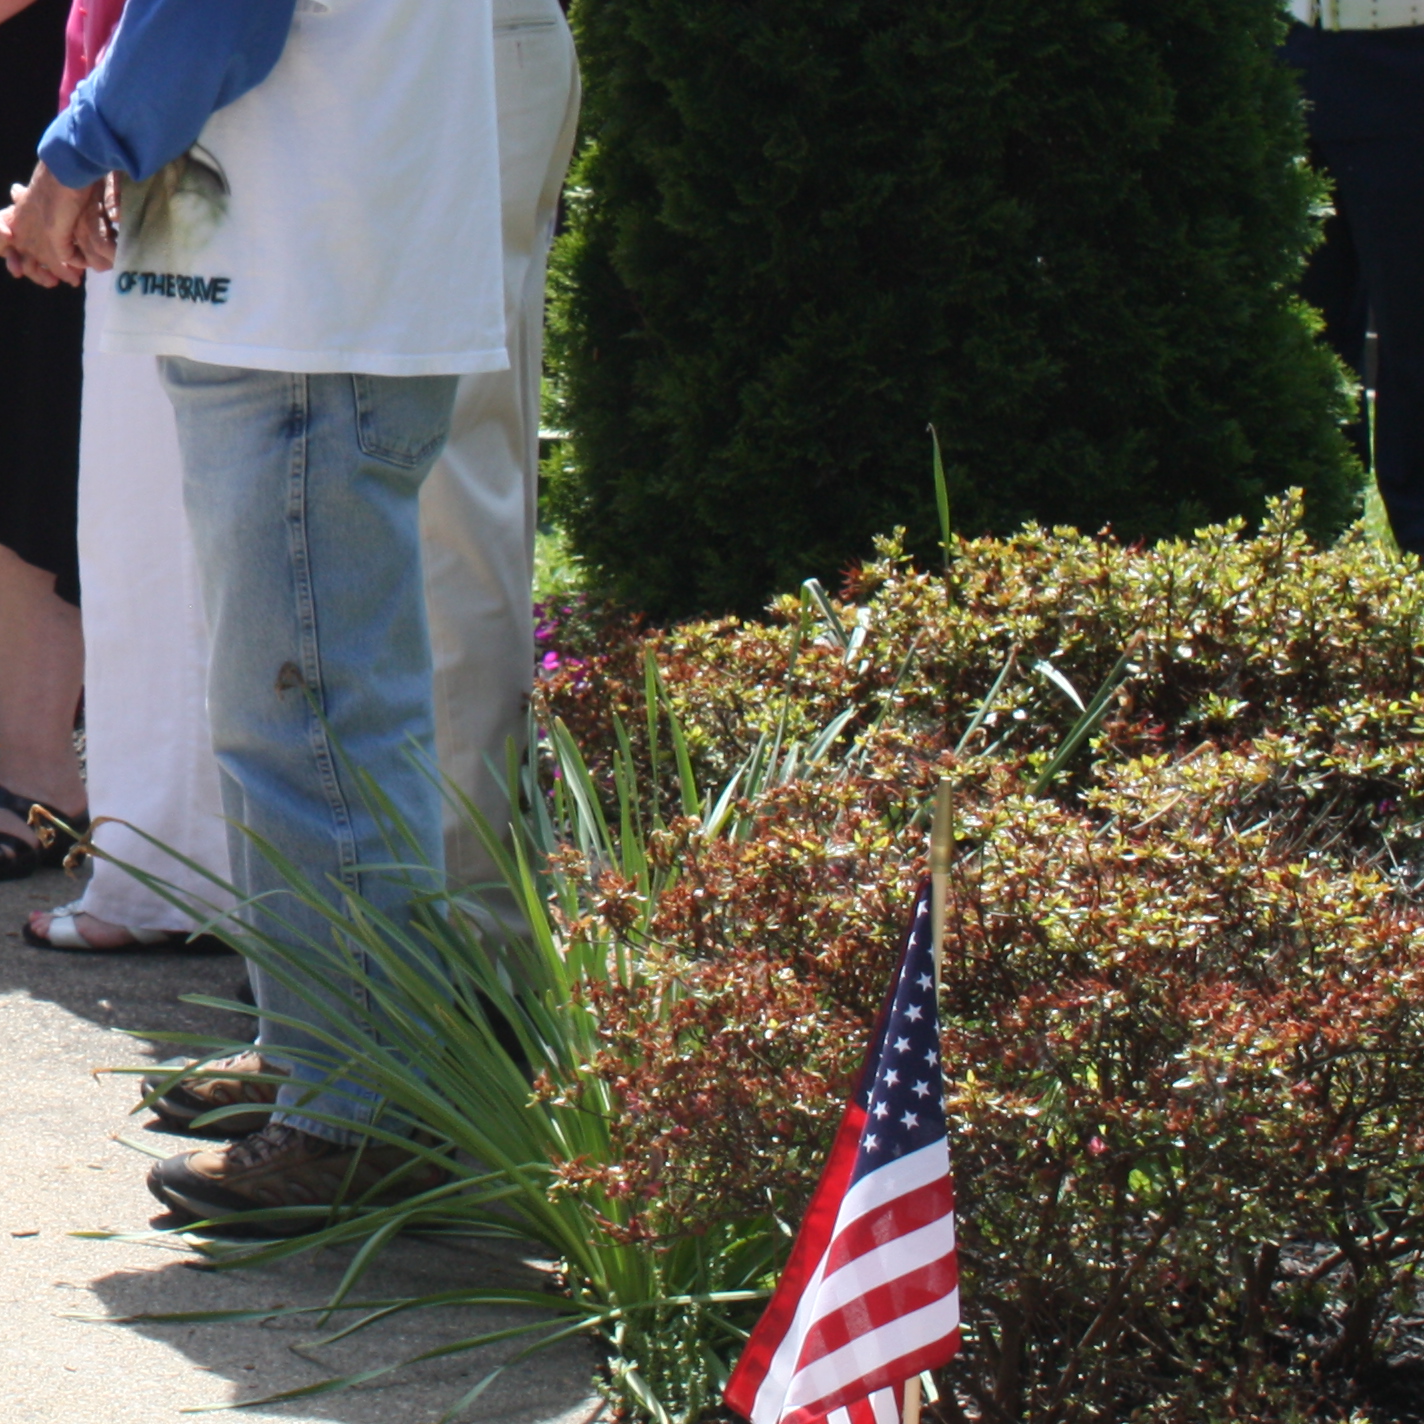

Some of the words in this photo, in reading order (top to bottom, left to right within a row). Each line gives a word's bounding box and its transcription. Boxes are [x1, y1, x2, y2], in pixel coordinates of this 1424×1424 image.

[118, 270, 138, 293] OF
[138, 271, 176, 298] THE
[176, 274, 231, 304] BRAVE
